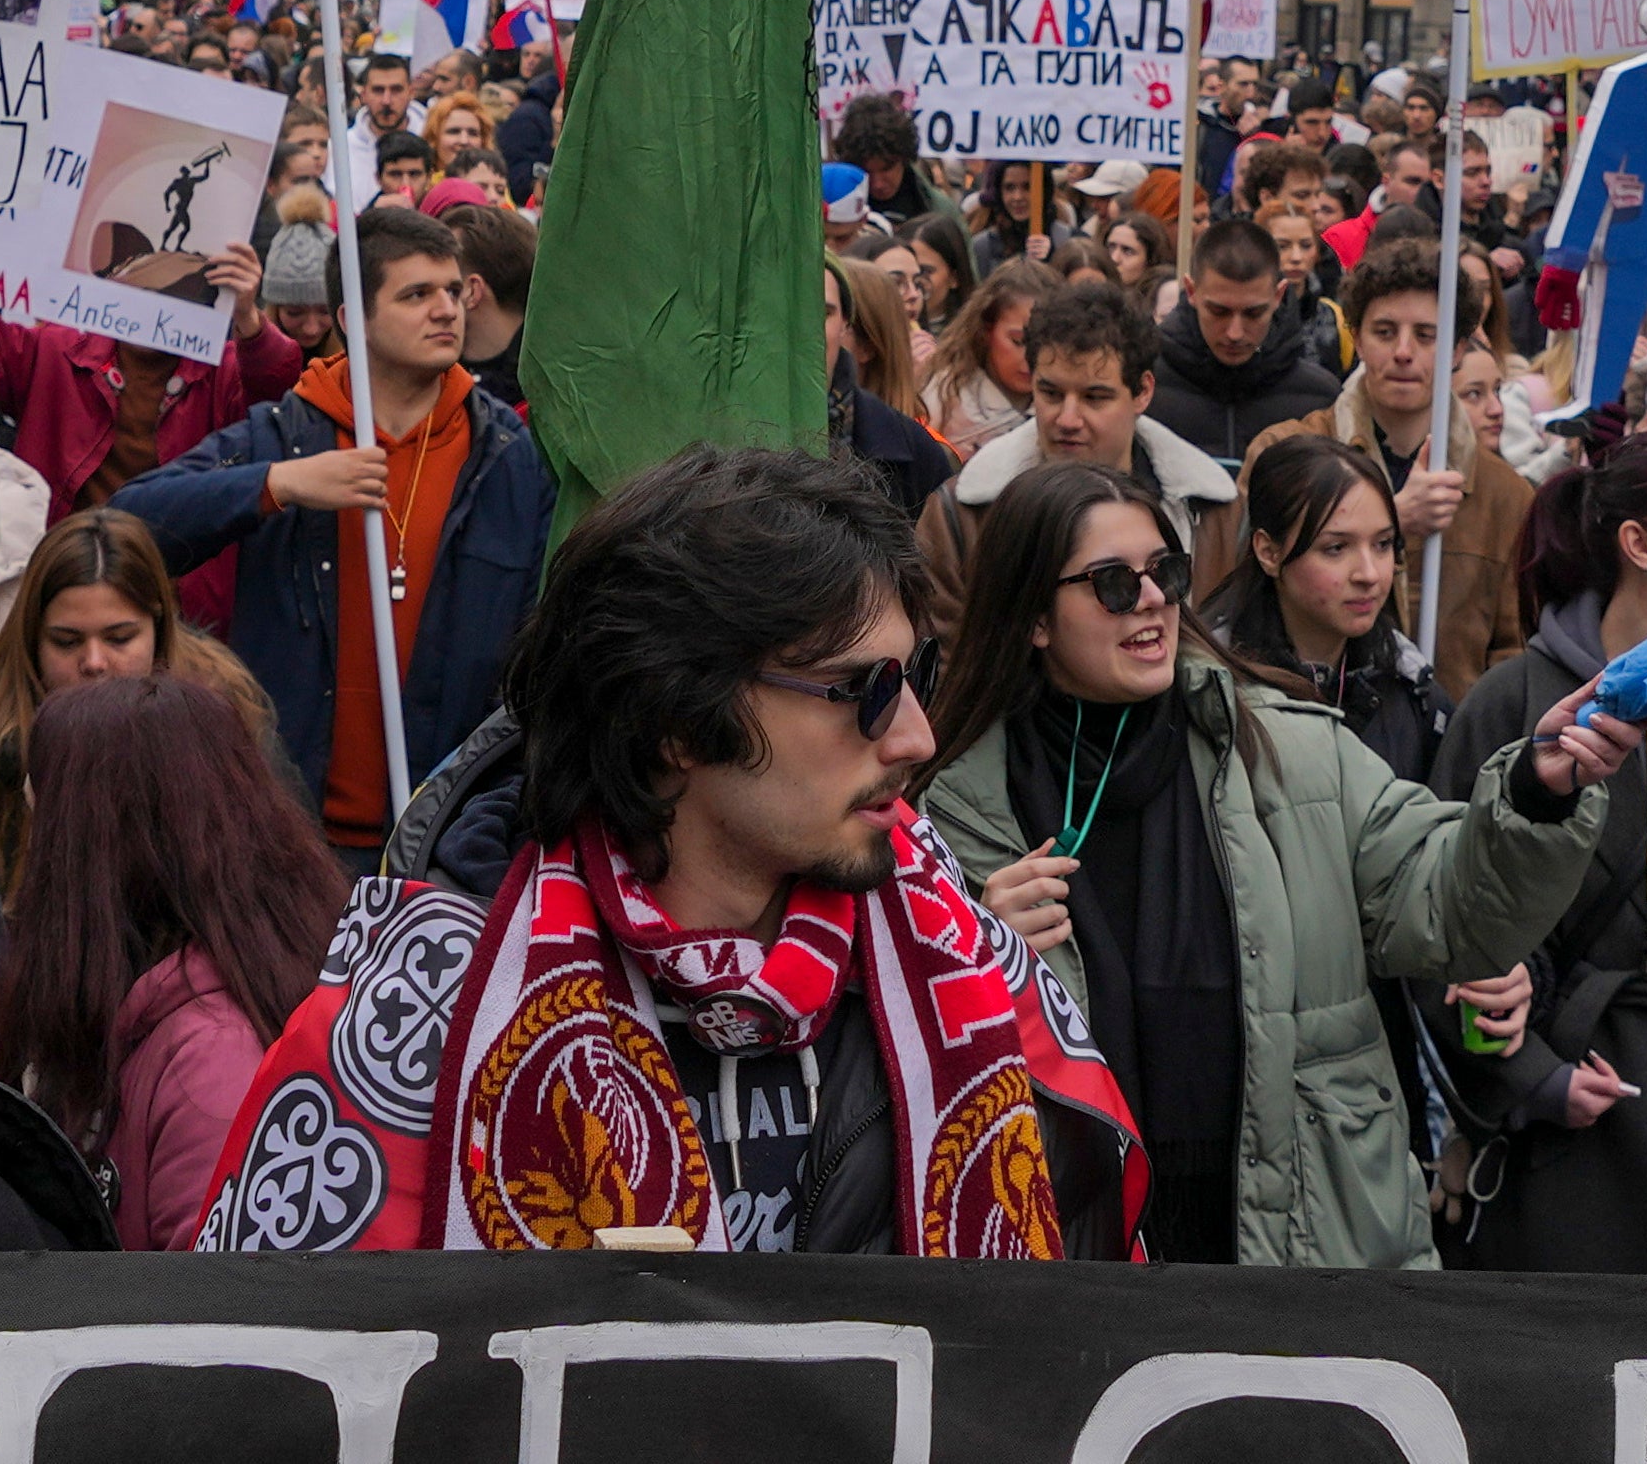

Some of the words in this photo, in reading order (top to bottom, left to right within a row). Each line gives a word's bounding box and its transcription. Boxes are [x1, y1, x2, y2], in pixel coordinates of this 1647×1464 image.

[821, 31, 861, 59] ДА
[980, 50, 1016, 86] ГА
[1036, 50, 1123, 87] ГУЛИ
[995, 113, 1061, 148] КАКО
[1075, 113, 1182, 157] СТИГНЕ
[151, 306, 212, 357] Ками
